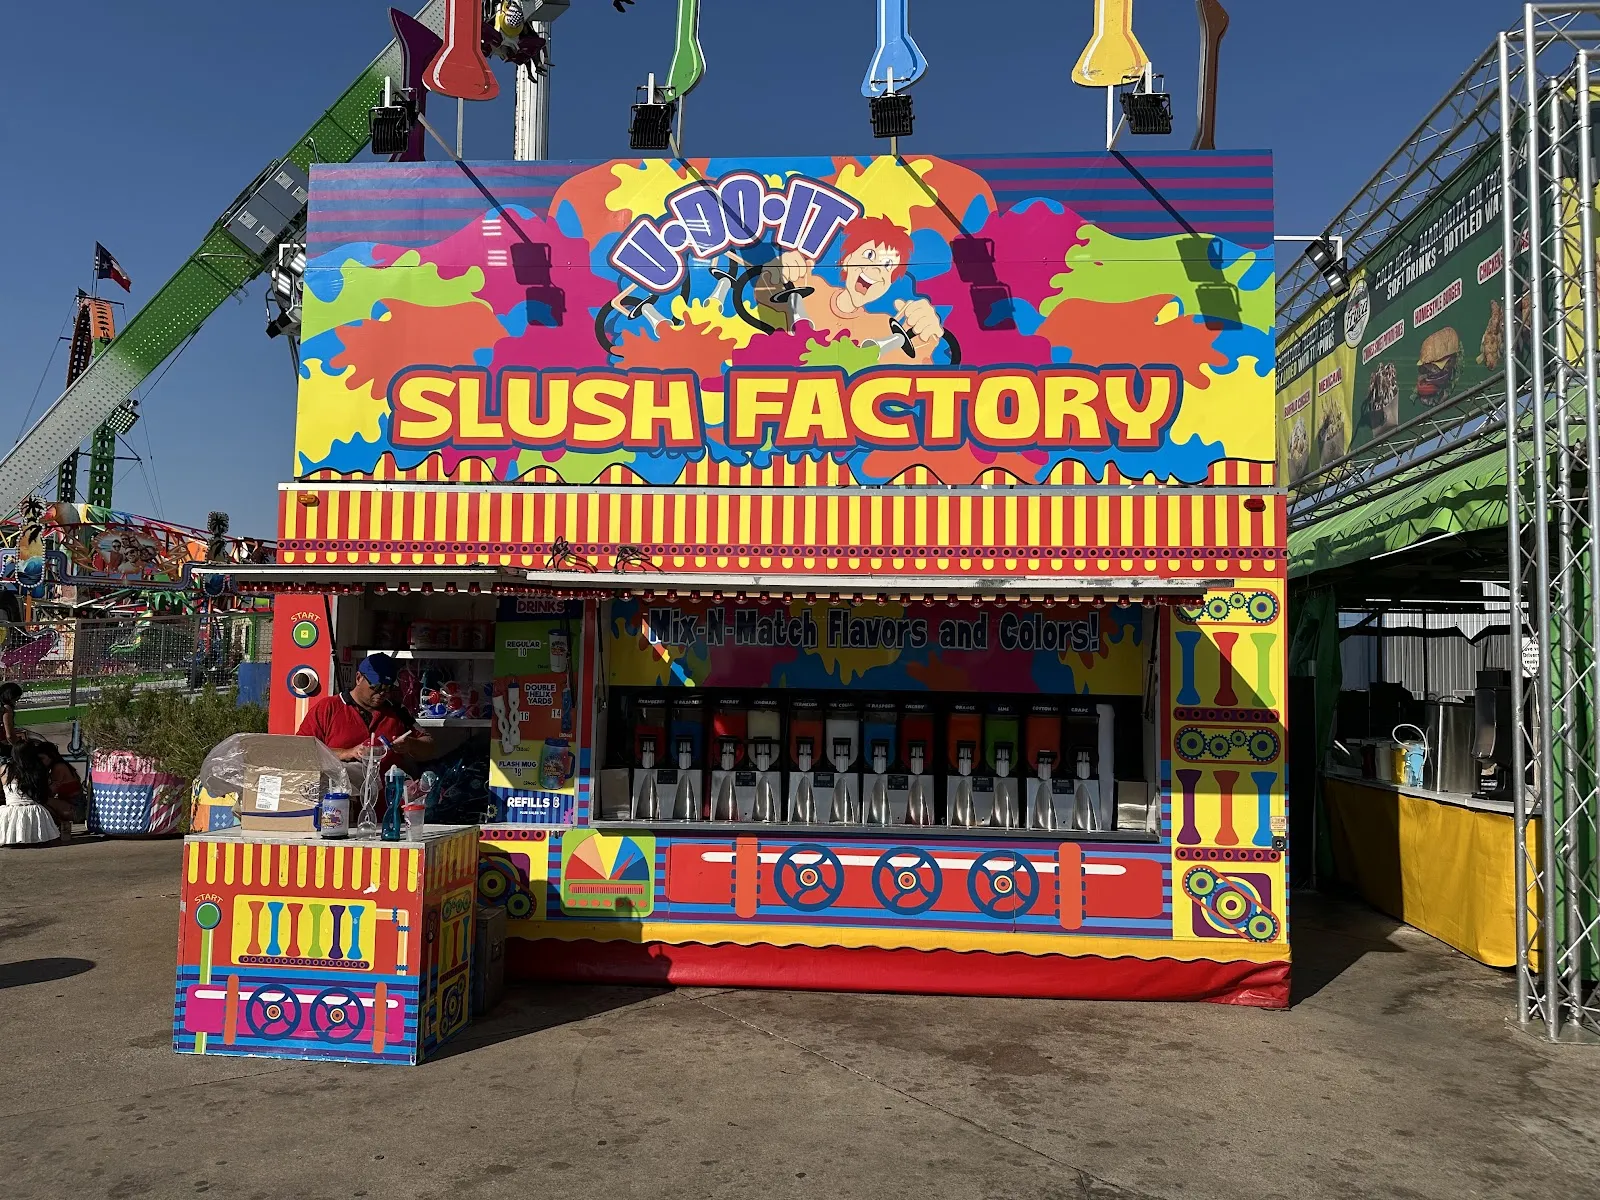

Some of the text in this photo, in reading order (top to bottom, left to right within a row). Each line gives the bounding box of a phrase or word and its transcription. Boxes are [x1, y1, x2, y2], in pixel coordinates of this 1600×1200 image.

[1375, 261, 1393, 290] COLD
[1419, 196, 1467, 254] MARGARITA
[1469, 182, 1482, 211] ON
[1387, 271, 1405, 300] SOFT
[1405, 247, 1436, 286] DRINKS
[1444, 209, 1482, 257] BOTTLED
[1415, 294, 1442, 326] HOMESTYLE
[392, 369, 1178, 447] SLUSH FACTORY
[516, 599, 566, 614] DRINKS
[291, 611, 322, 623] START
[649, 607, 1099, 652] Mix-N-Match Flavors and Colors!
[506, 640, 541, 649] REGULAR
[518, 648, 528, 658] 10
[525, 684, 556, 692] DOUBLE
[527, 697, 553, 705] YARDS
[520, 712, 529, 721] 16
[552, 709, 562, 718] 14
[499, 760, 537, 769] FLASH MUG
[507, 797, 551, 808] REFILLS
[194, 893, 224, 905] START
